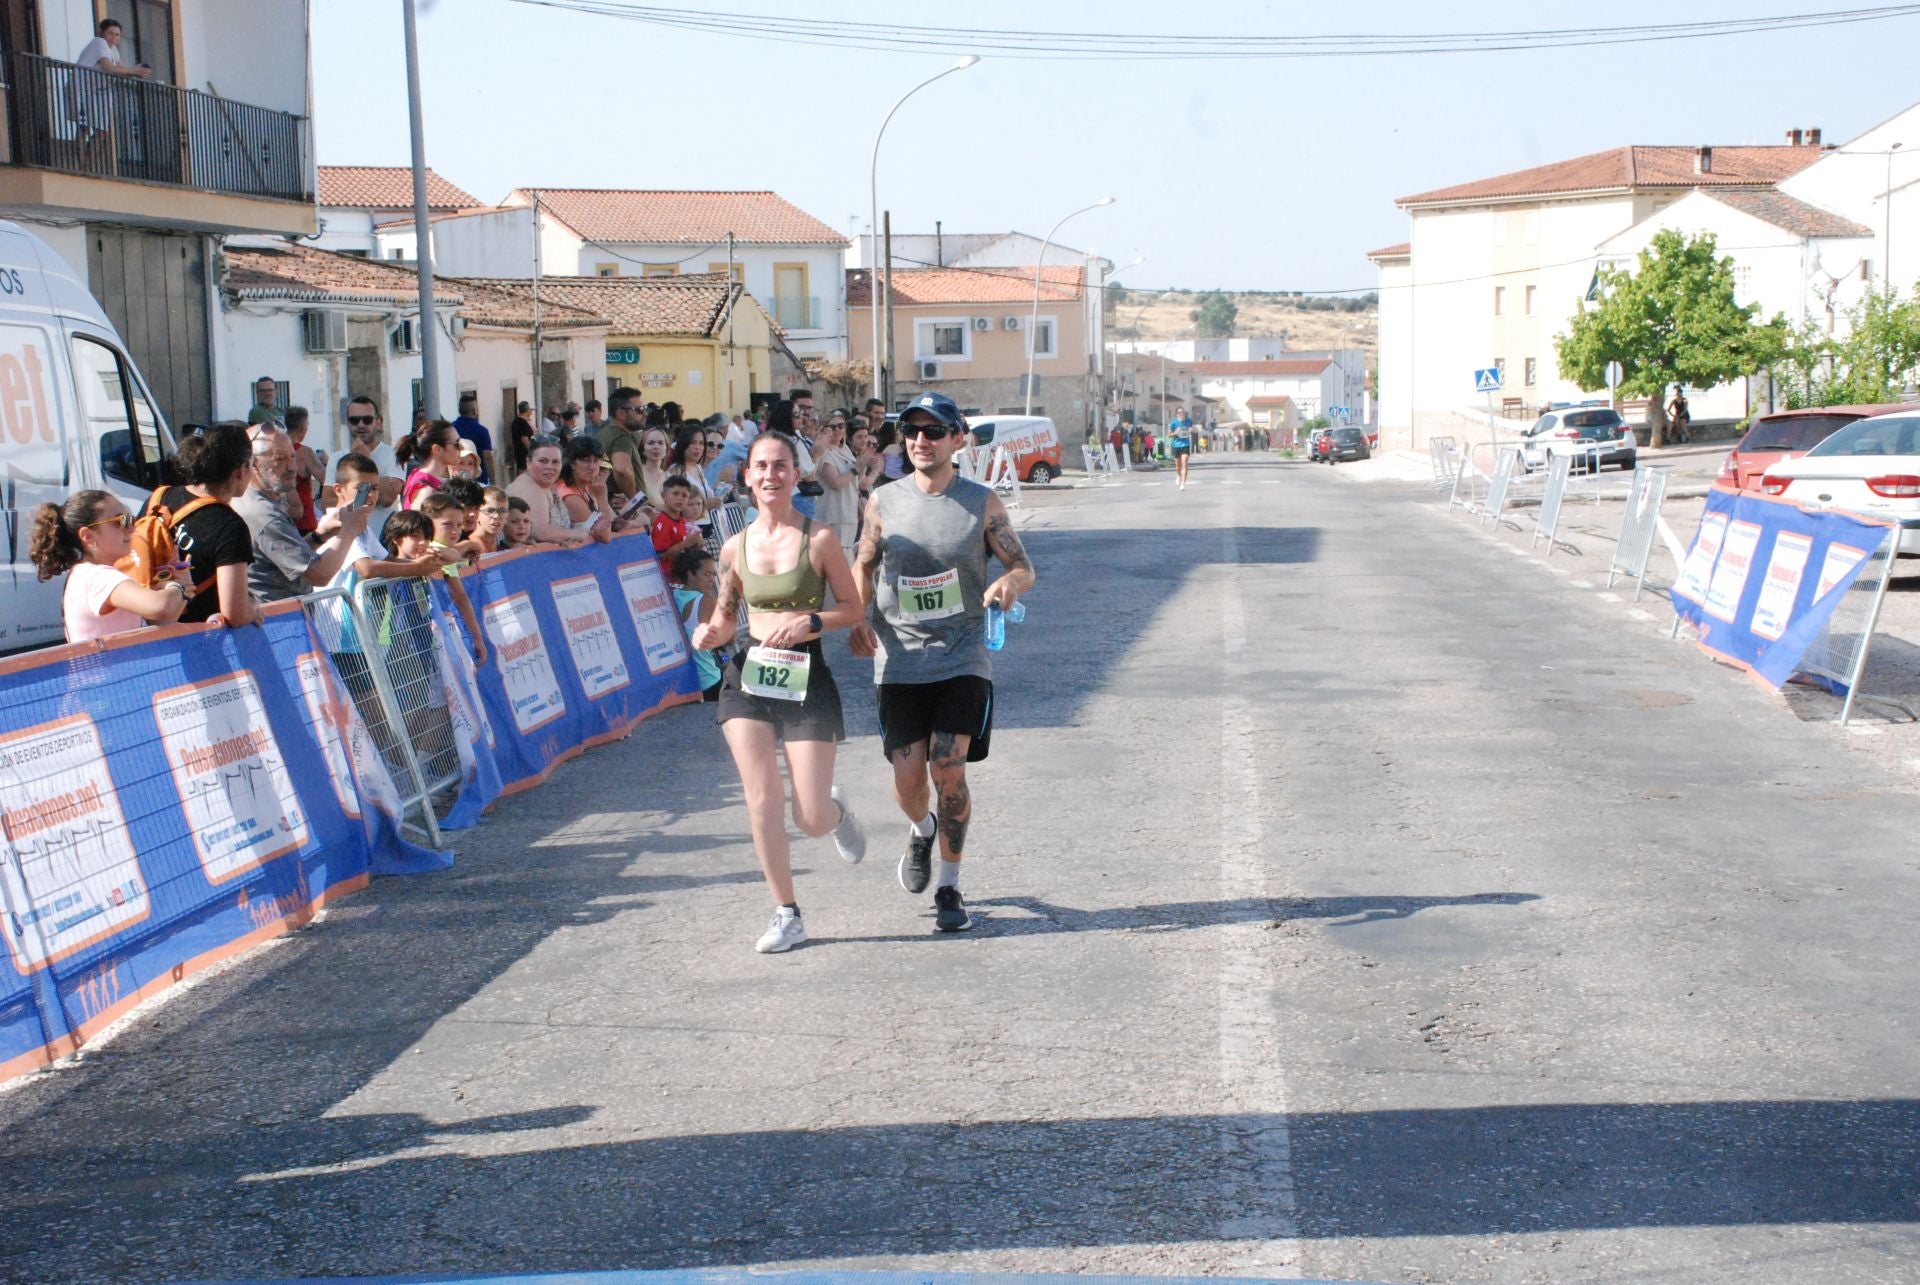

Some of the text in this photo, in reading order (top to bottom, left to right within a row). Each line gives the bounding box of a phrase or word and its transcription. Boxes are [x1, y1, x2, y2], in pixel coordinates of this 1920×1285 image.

[0, 344, 56, 445] et
[908, 579, 928, 587] CROSS
[928, 572, 953, 585] POPULAR
[913, 590, 944, 611] 167
[778, 652, 805, 662] POPULAR
[757, 665, 790, 689] 132
[15, 750, 26, 764] DE
[25, 740, 55, 763] EVENTOS
[54, 730, 93, 754] DEPORTIVOS
[180, 726, 270, 777] Pulsaciones.net
